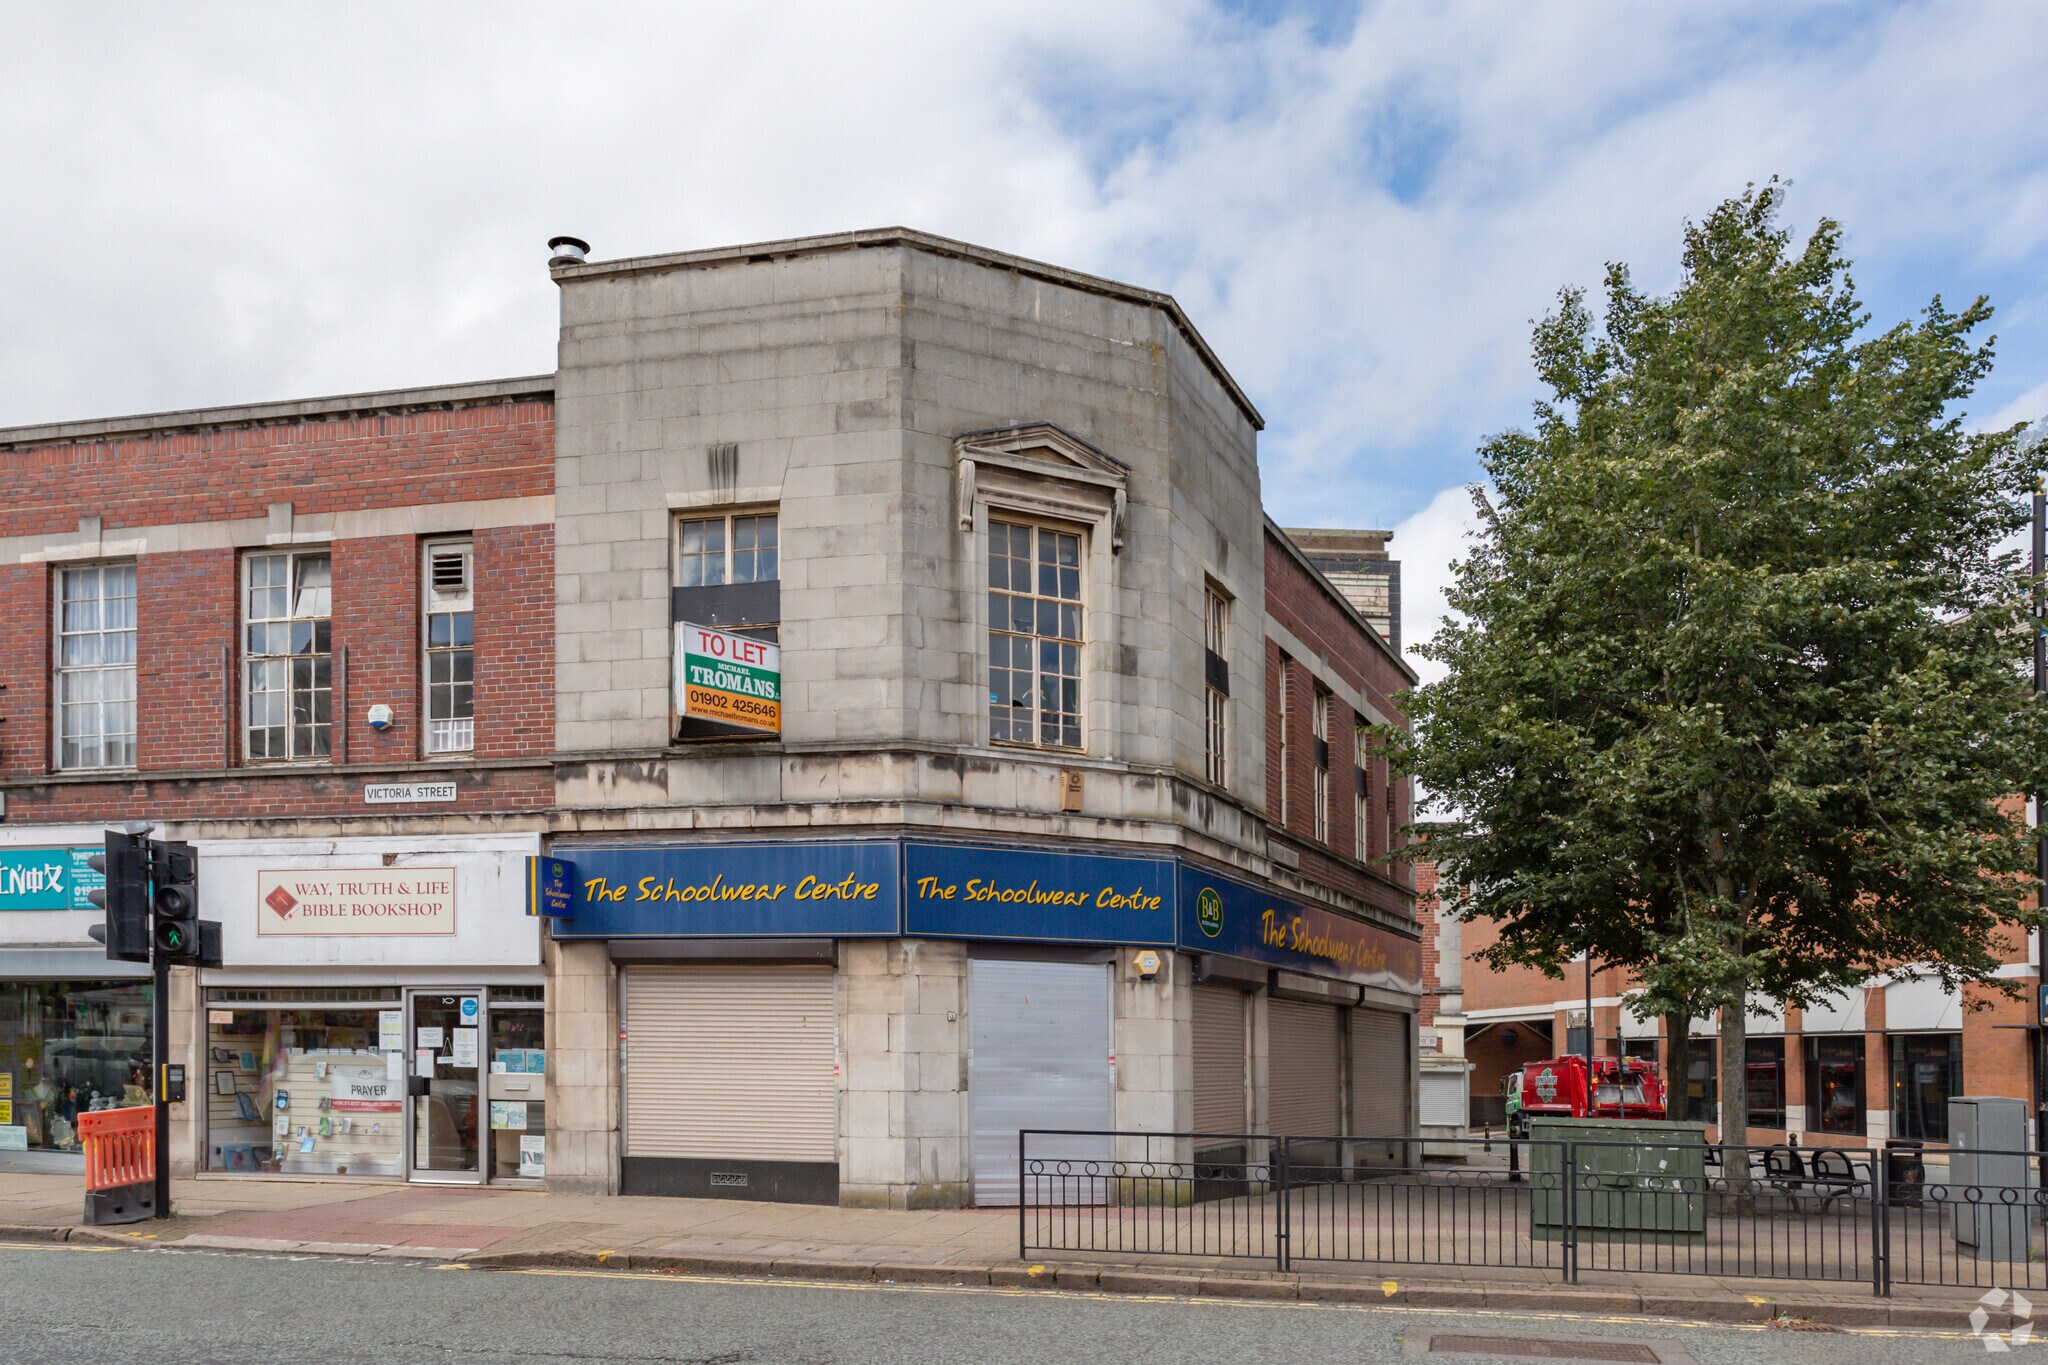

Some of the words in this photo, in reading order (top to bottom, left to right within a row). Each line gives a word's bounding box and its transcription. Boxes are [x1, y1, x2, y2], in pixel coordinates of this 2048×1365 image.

[698, 632, 725, 656] TO
[732, 639, 767, 665] LET
[717, 663, 750, 675] MICHAEL
[690, 665, 775, 698] TROMANS
[691, 690, 728, 708] 01902
[733, 698, 776, 718] 425646
[691, 706, 775, 727] www.michaeltromans.co.uk
[367, 787, 412, 800] VICTORIA
[417, 785, 455, 798] STREET
[295, 883, 332, 897] WAY,
[337, 882, 393, 895] TRUTH
[397, 882, 410, 895] &
[417, 881, 449, 894] LIFE
[554, 879, 562, 887] The
[585, 877, 628, 902] The
[635, 874, 787, 903] Schoolwear
[794, 872, 880, 901] Centre
[917, 876, 957, 900] The
[963, 879, 1089, 906] Schoolwear
[1096, 886, 1161, 911] Centre
[302, 904, 347, 917] BIBLE
[352, 902, 442, 916] BOOKSHOP
[1202, 896, 1219, 920] B&B
[1262, 909, 1286, 948] The
[1291, 916, 1355, 962] Schoolwear
[1356, 937, 1386, 969] Centre
[351, 1085, 387, 1095] PRAYER
